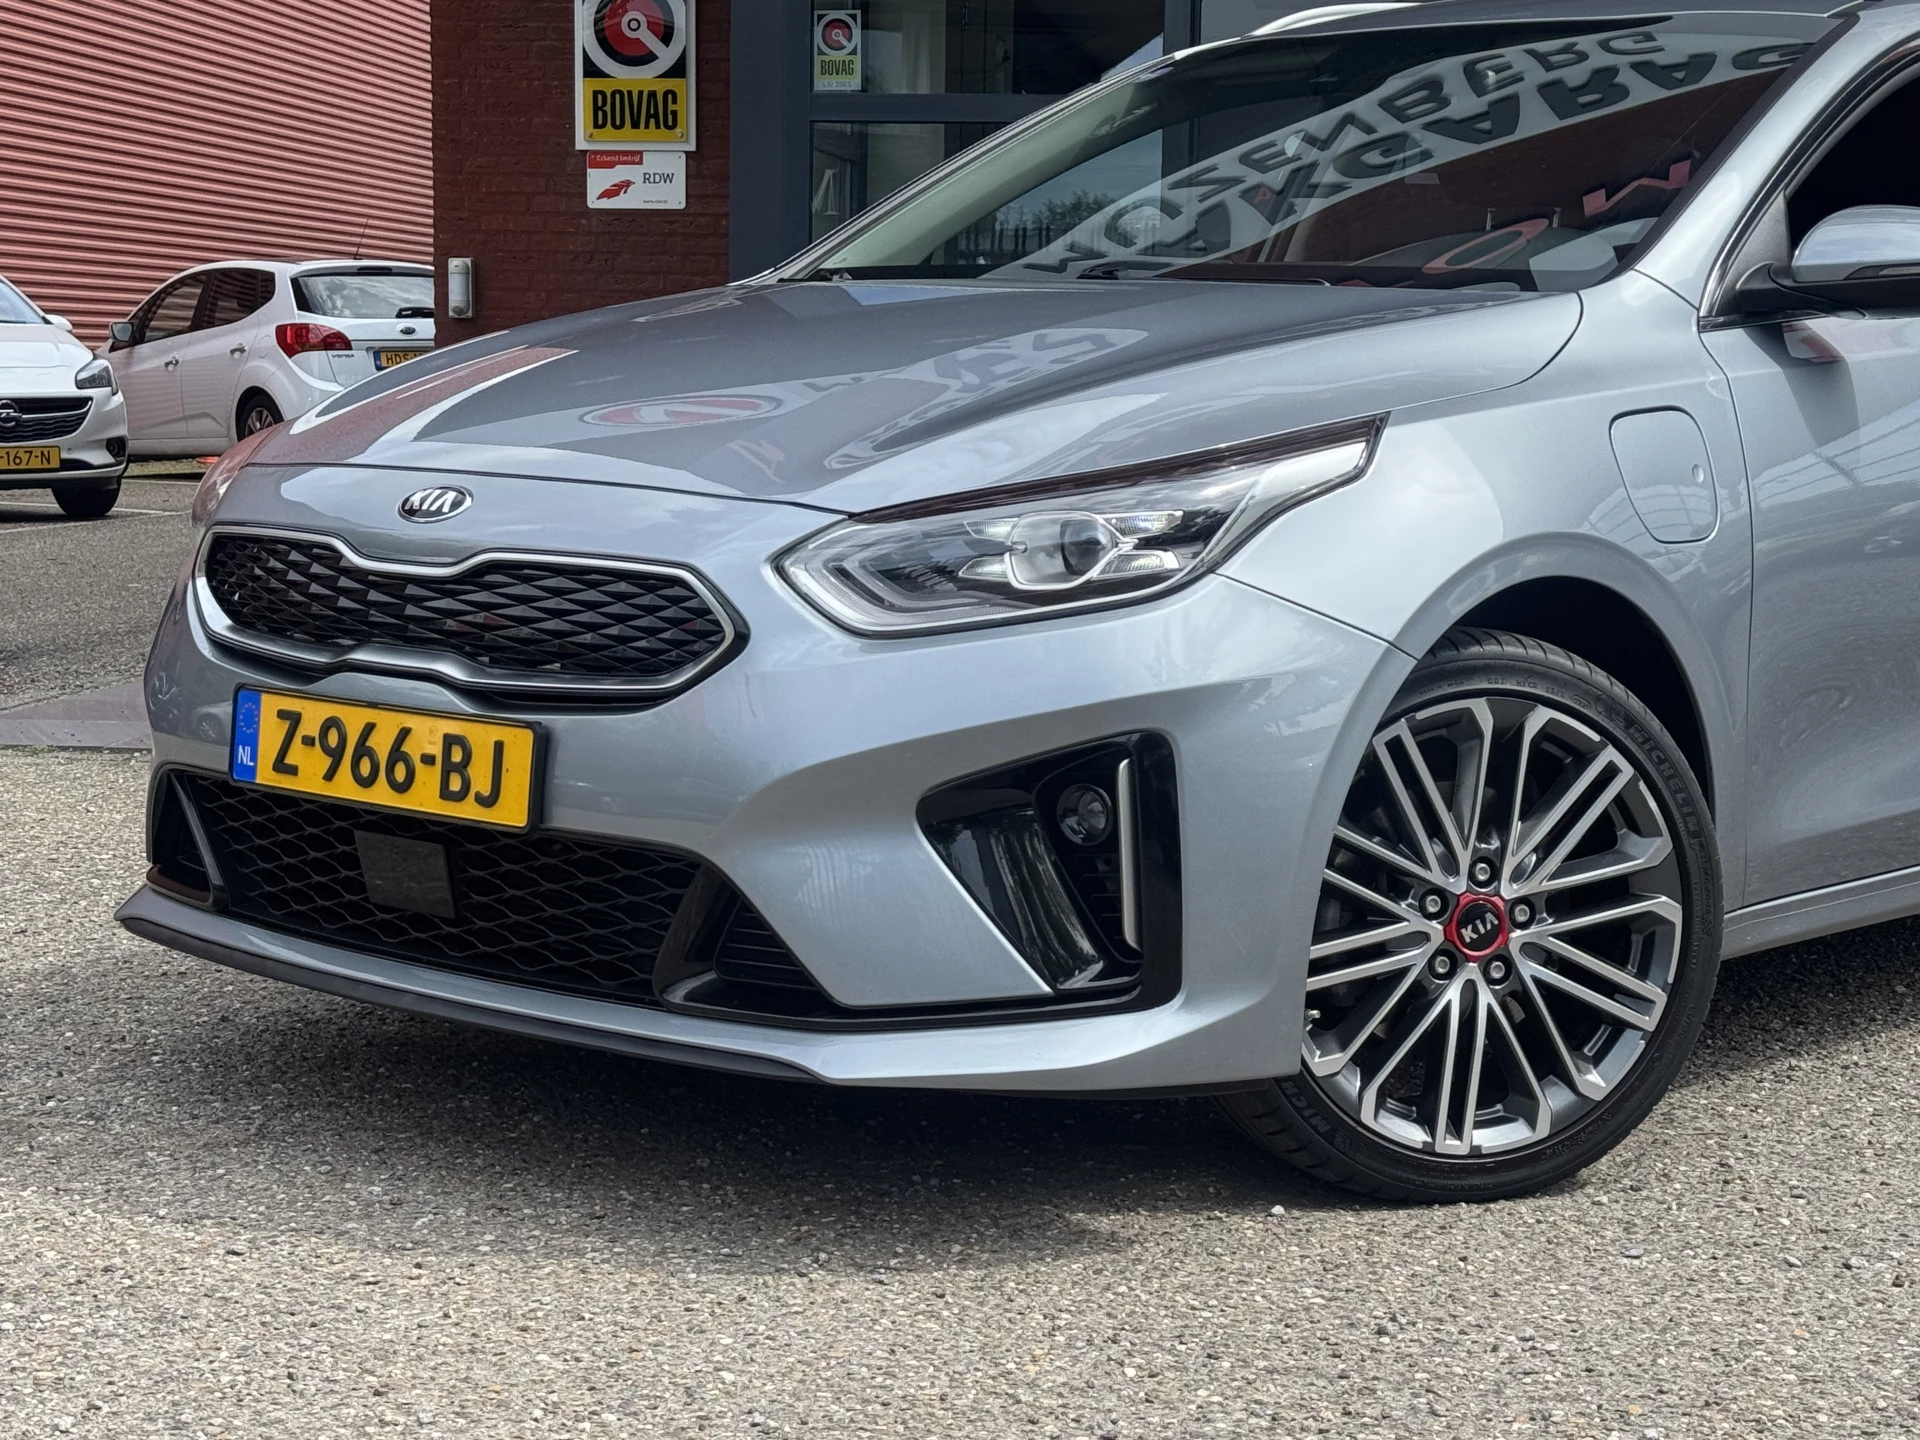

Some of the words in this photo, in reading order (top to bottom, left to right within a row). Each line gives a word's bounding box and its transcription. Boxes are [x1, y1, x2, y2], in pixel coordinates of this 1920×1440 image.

[820, 59, 855, 76] BOVAG
[592, 89, 678, 130] BOVAG
[642, 172, 675, 184] RDW
[404, 488, 458, 513] KIA
[237, 744, 255, 767] NL
[271, 708, 505, 809] Z-966-BJ
[1628, 723, 1699, 833] MICHELIN
[1460, 911, 1500, 943] KIA
